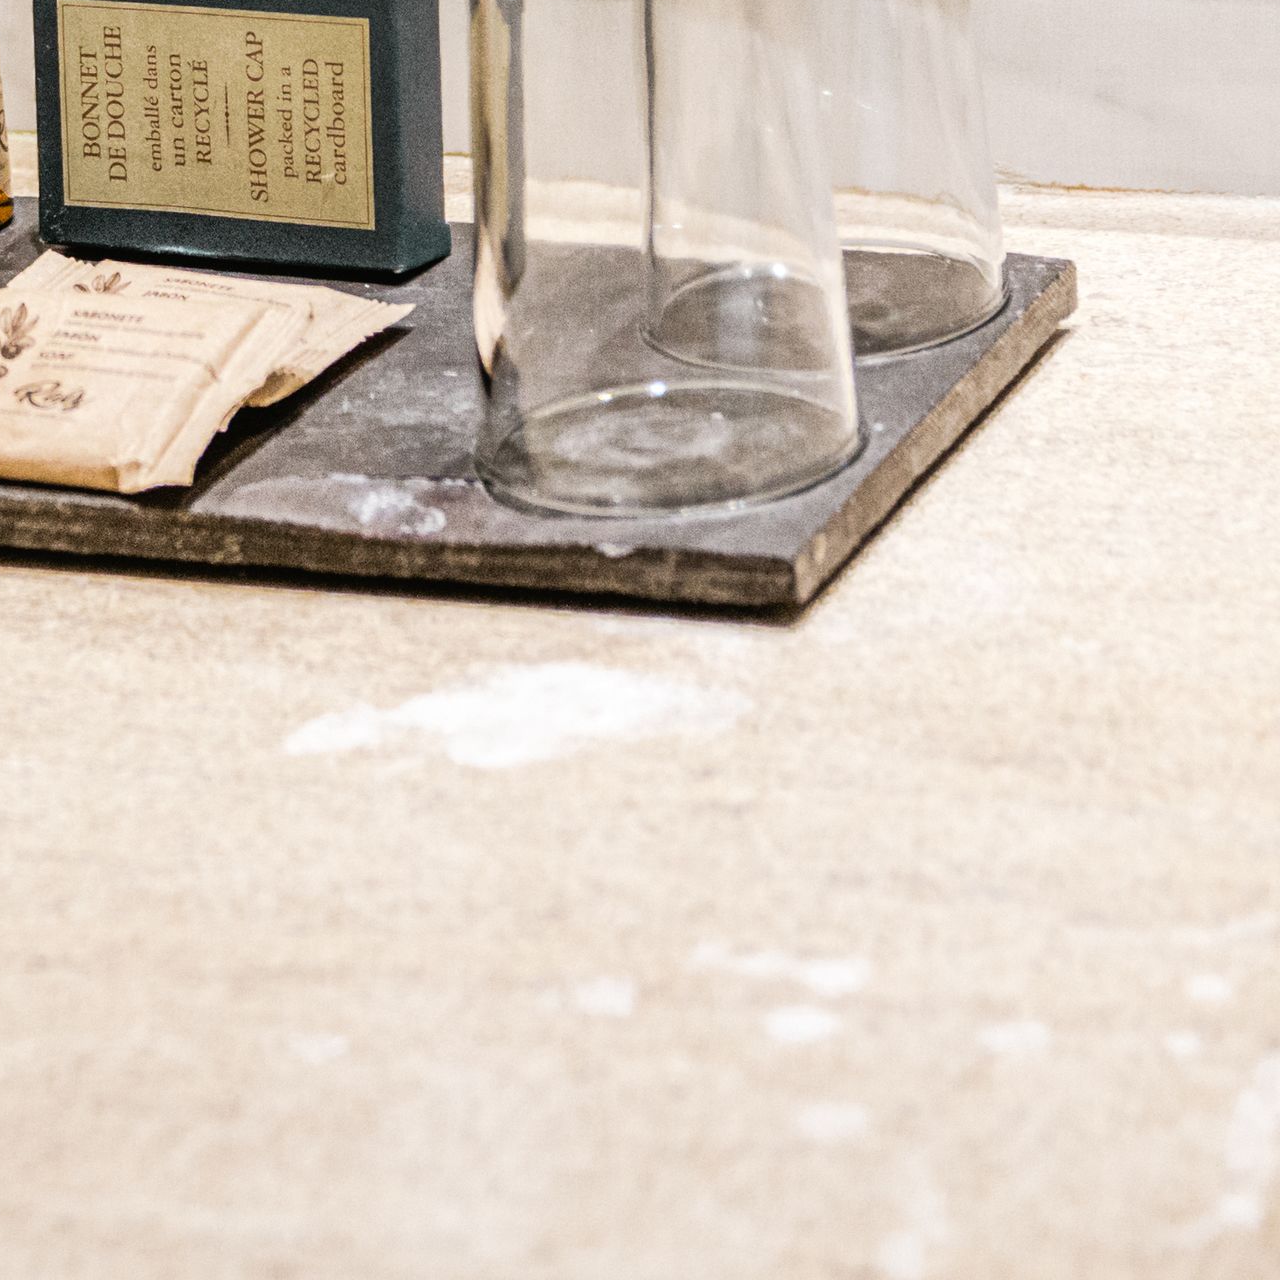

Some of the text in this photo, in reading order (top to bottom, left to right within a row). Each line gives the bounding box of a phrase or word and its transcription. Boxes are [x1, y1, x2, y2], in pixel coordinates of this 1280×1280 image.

[77, 45, 102, 160] BONNET
[102, 24, 129, 184] DE DOUCHE
[142, 44, 163, 173] emballé dans
[167, 52, 188, 169] un carton
[186, 58, 213, 167] RECYCLÉ
[245, 30, 269, 204] SHOWER CAP
[274, 65, 300, 180] packed in a
[302, 57, 323, 185] RECYCLED
[324, 61, 348, 186] cardboard
